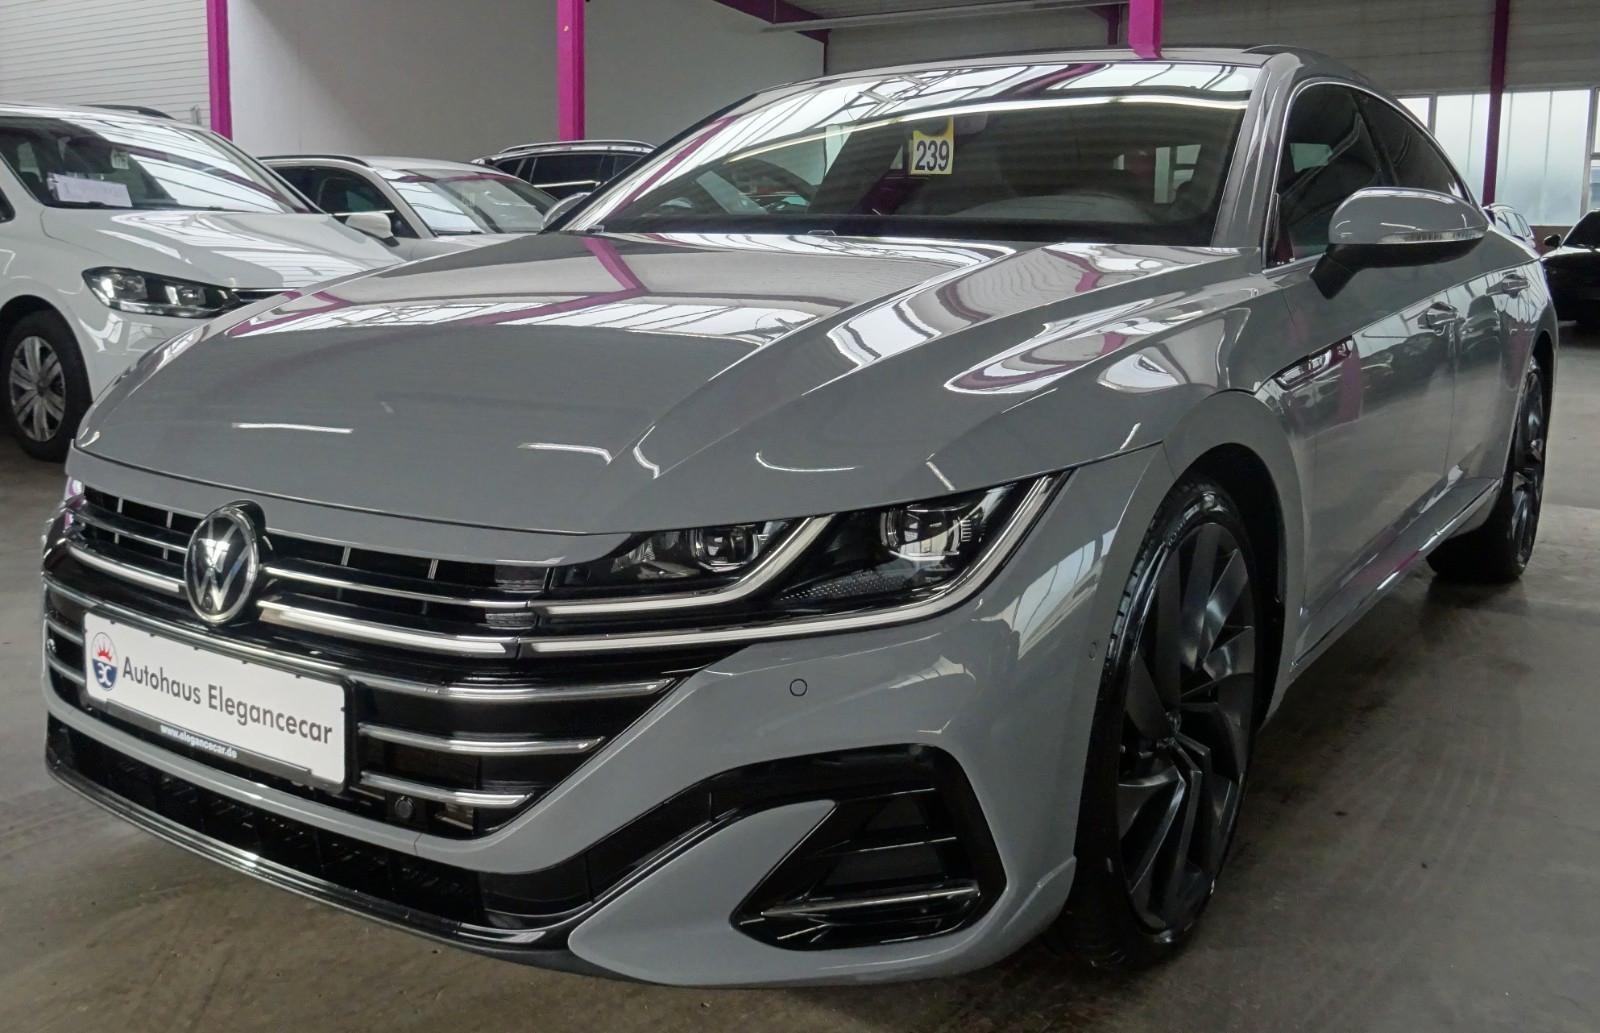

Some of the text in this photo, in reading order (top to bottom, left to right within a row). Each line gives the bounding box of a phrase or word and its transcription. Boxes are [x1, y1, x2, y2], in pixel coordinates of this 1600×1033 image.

[915, 140, 950, 171] 239
[122, 657, 333, 744] Autohaus Elegancecar
